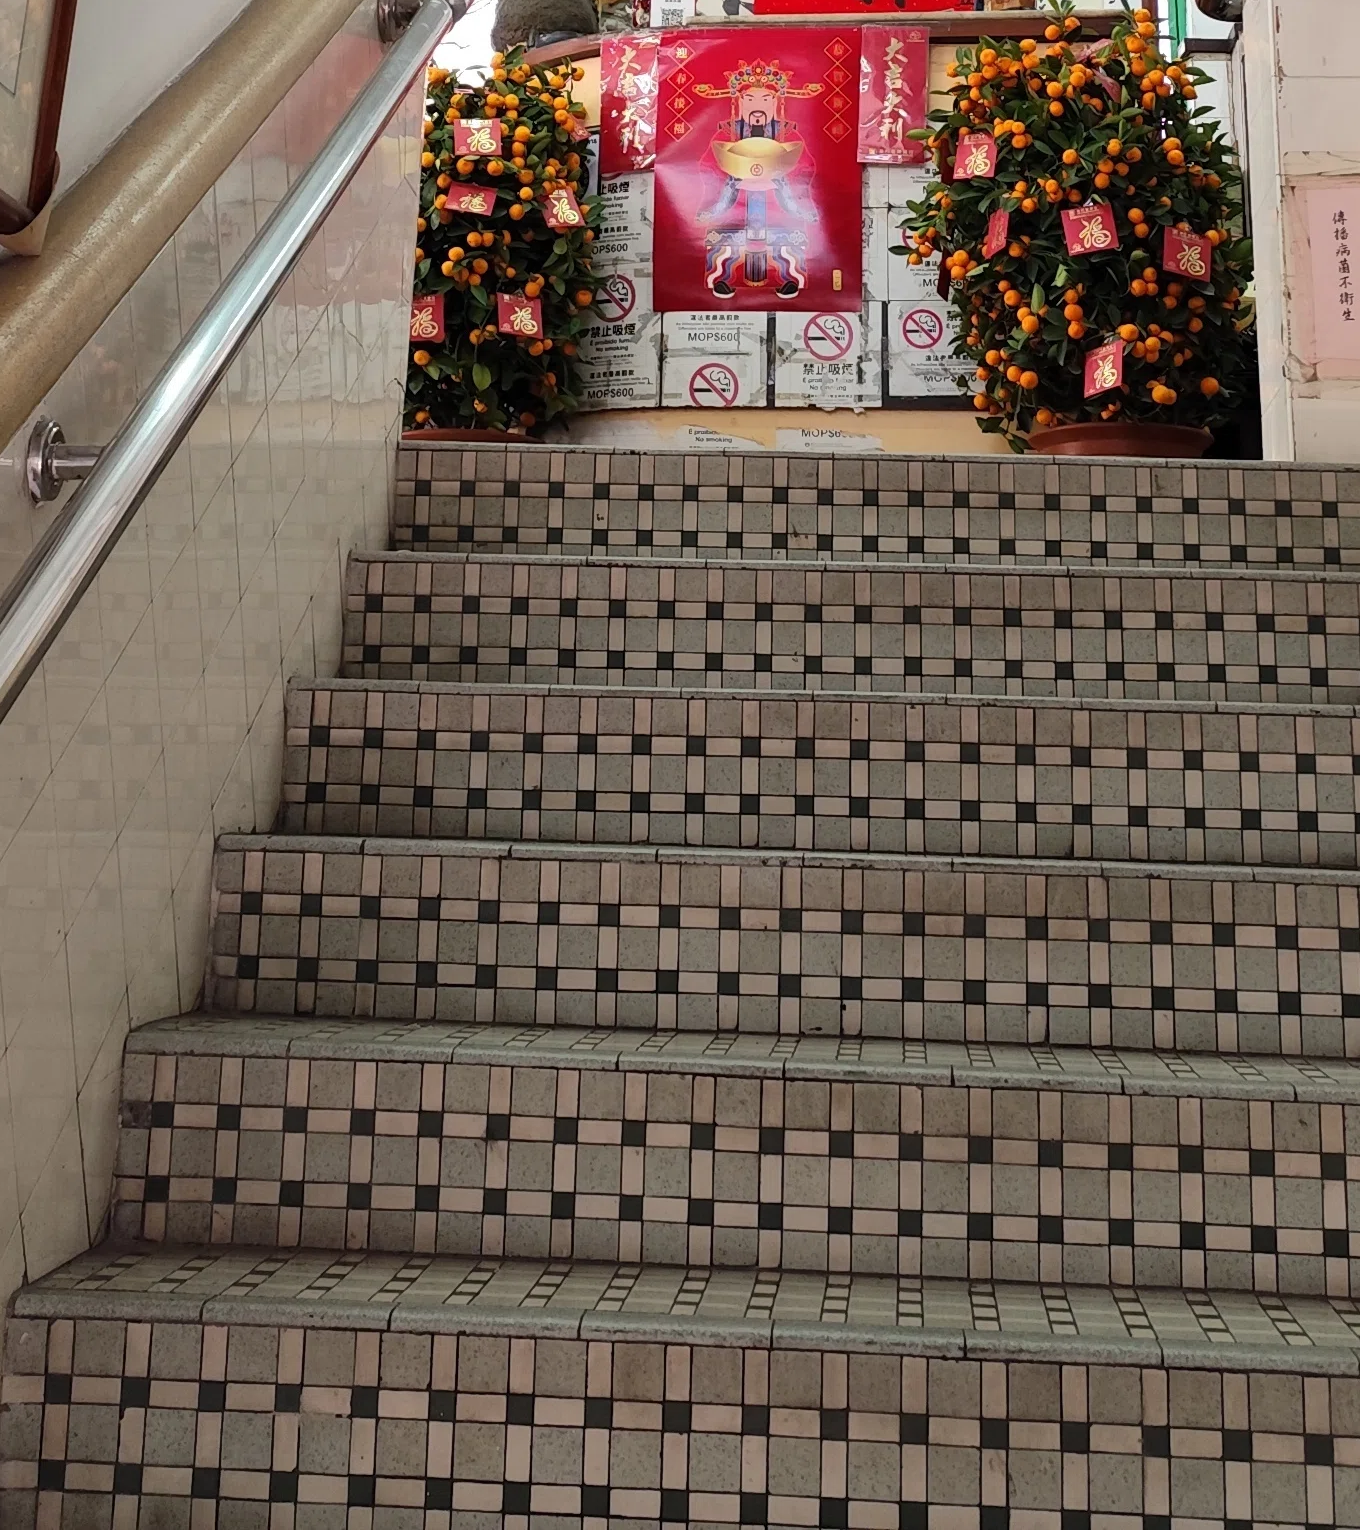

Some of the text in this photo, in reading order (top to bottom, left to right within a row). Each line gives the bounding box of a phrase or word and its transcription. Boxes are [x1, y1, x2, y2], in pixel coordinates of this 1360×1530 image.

[879, 37, 910, 141] 大吉大利
[467, 127, 498, 153] 福
[965, 144, 991, 176] 福
[600, 181, 630, 195] 止吸煙
[550, 197, 580, 224] 福
[1079, 215, 1112, 248] 福
[1177, 244, 1206, 276] 福
[411, 306, 439, 338] 福
[510, 306, 539, 335] 福
[1093, 354, 1118, 390] 福
